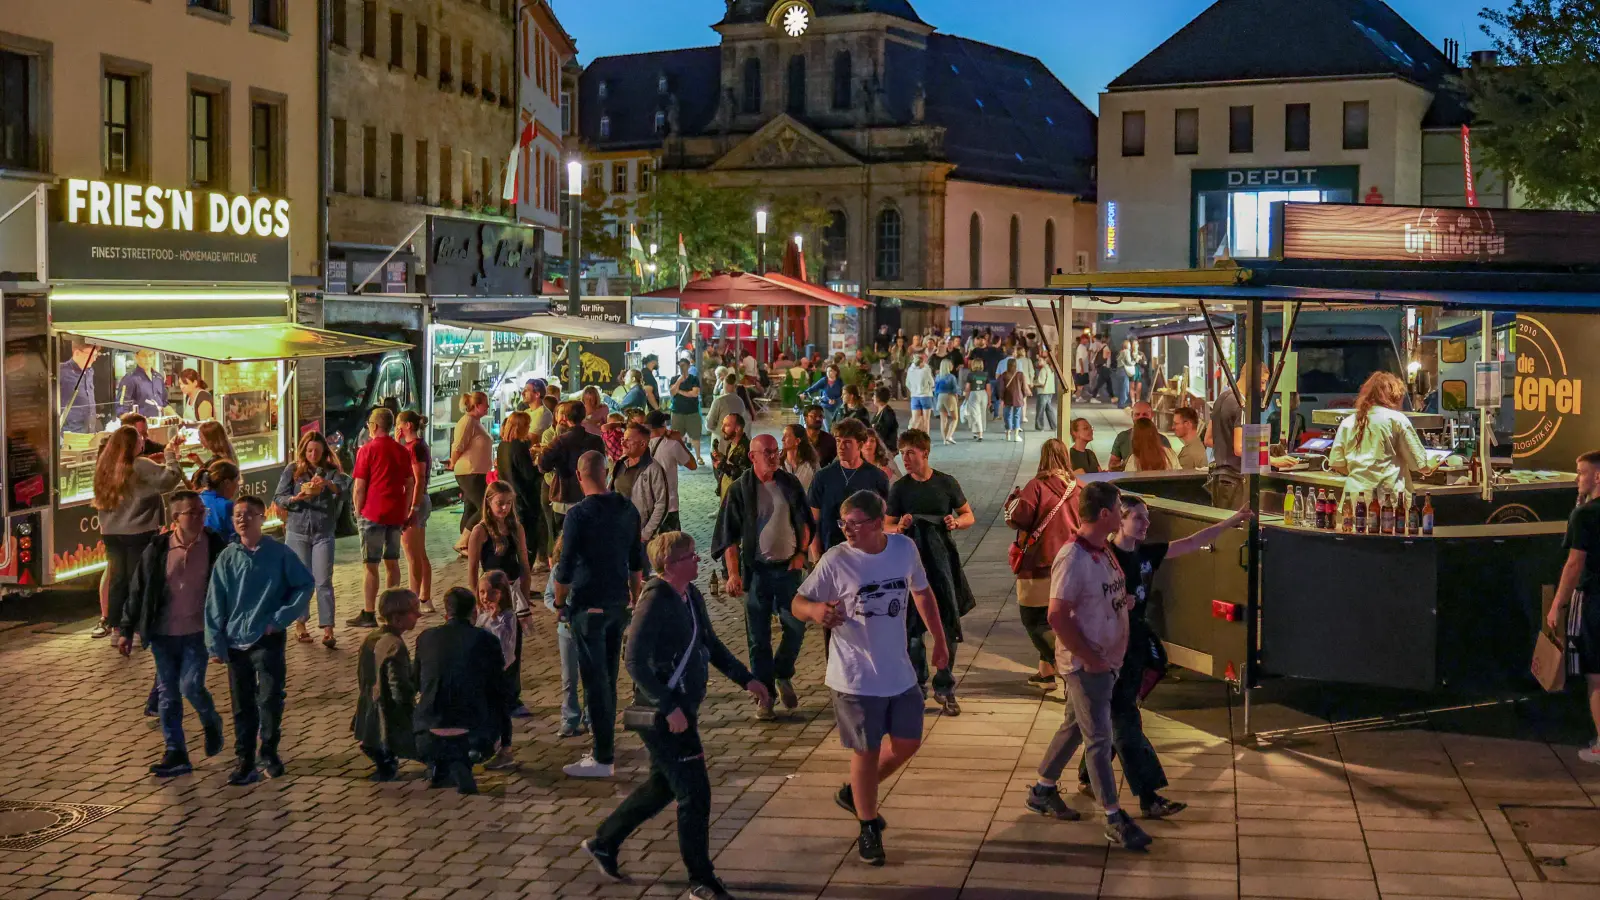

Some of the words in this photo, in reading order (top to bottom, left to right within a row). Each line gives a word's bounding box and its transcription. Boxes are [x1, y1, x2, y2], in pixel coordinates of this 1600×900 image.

[1227, 169, 1317, 185] DEPOT
[209, 192, 290, 238] DOGS
[1107, 201, 1115, 249] INTERSPORT
[91, 246, 120, 258] FINEST
[121, 247, 174, 260] STREETFOOD
[180, 250, 220, 262] HOMEMADE
[221, 252, 240, 263] WITH
[240, 252, 258, 264] LOVE
[604, 313, 621, 323] Party
[1519, 323, 1537, 337] 2010
[1517, 352, 1535, 374] die
